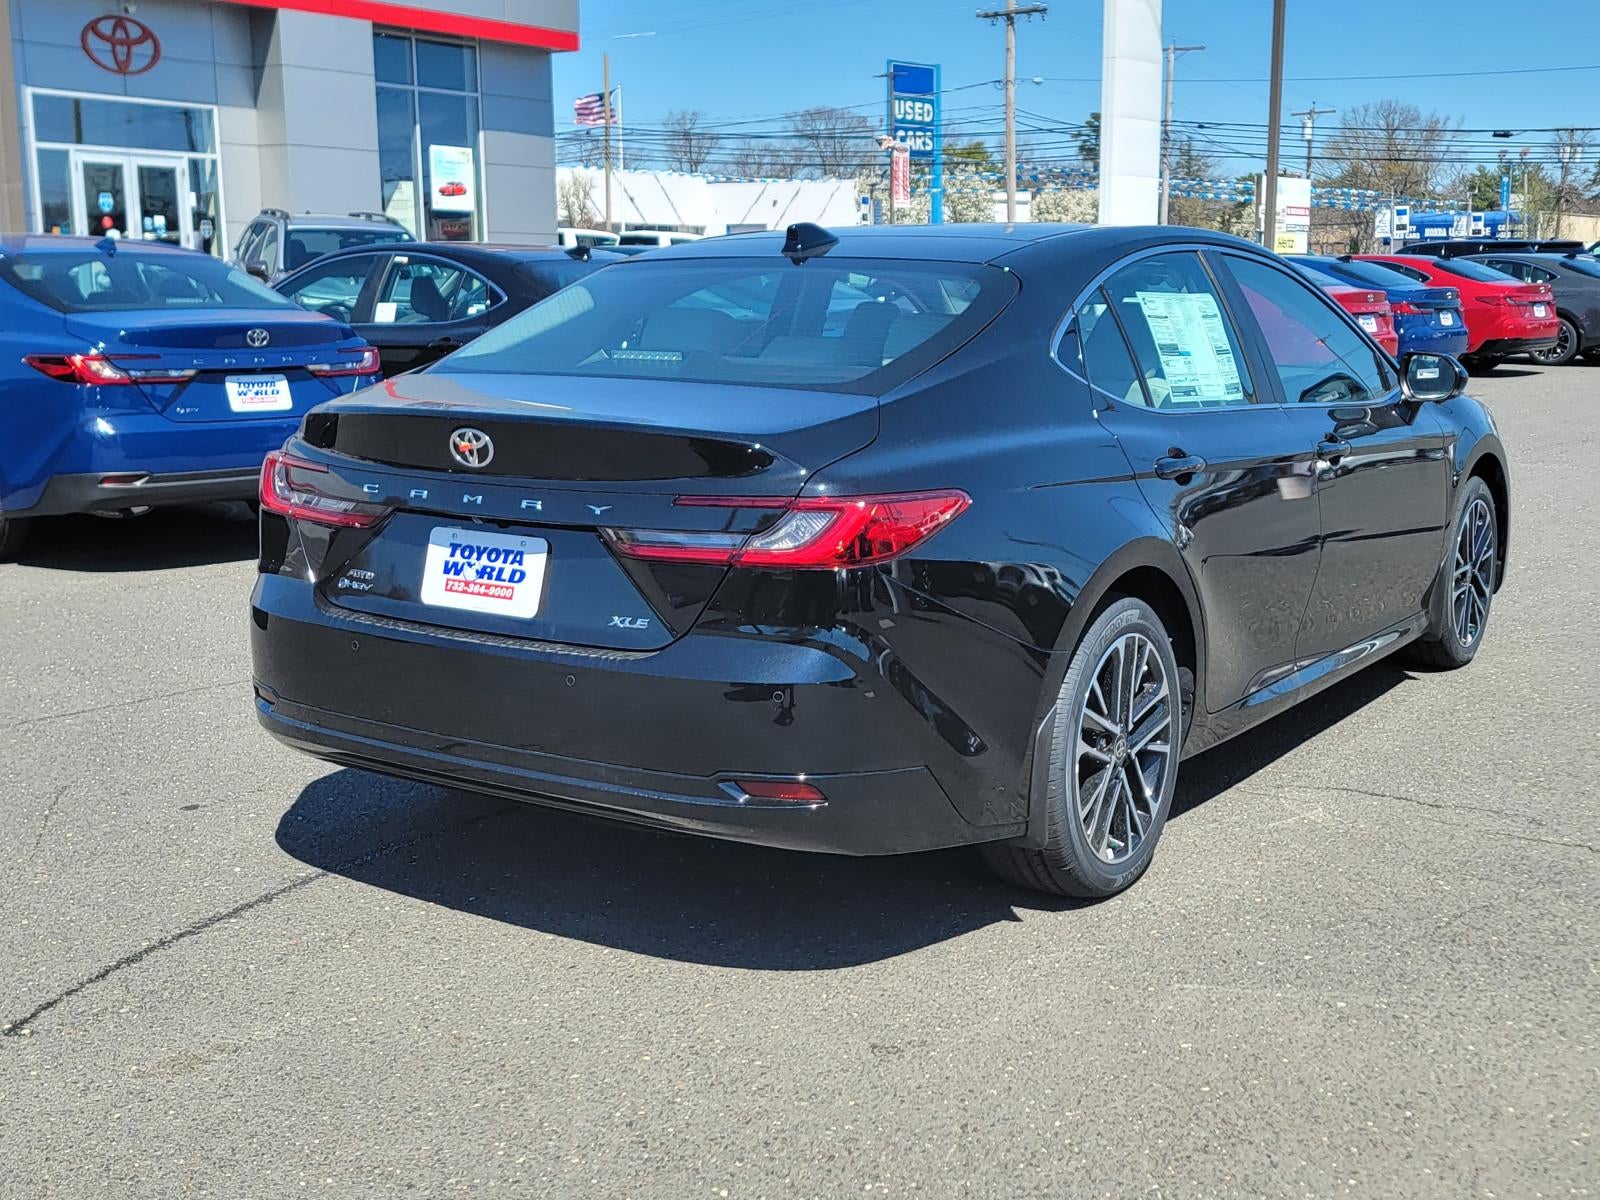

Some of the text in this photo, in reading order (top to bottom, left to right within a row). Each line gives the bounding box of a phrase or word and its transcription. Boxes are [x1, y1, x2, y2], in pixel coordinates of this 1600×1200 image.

[894, 99, 934, 122] USED
[895, 130, 934, 151] CARS
[237, 380, 276, 389] TOYOTA
[362, 483, 613, 515] CAMRY
[448, 542, 525, 566] TOYOTA
[443, 560, 526, 584] WORLD
[607, 615, 650, 629] XLE
